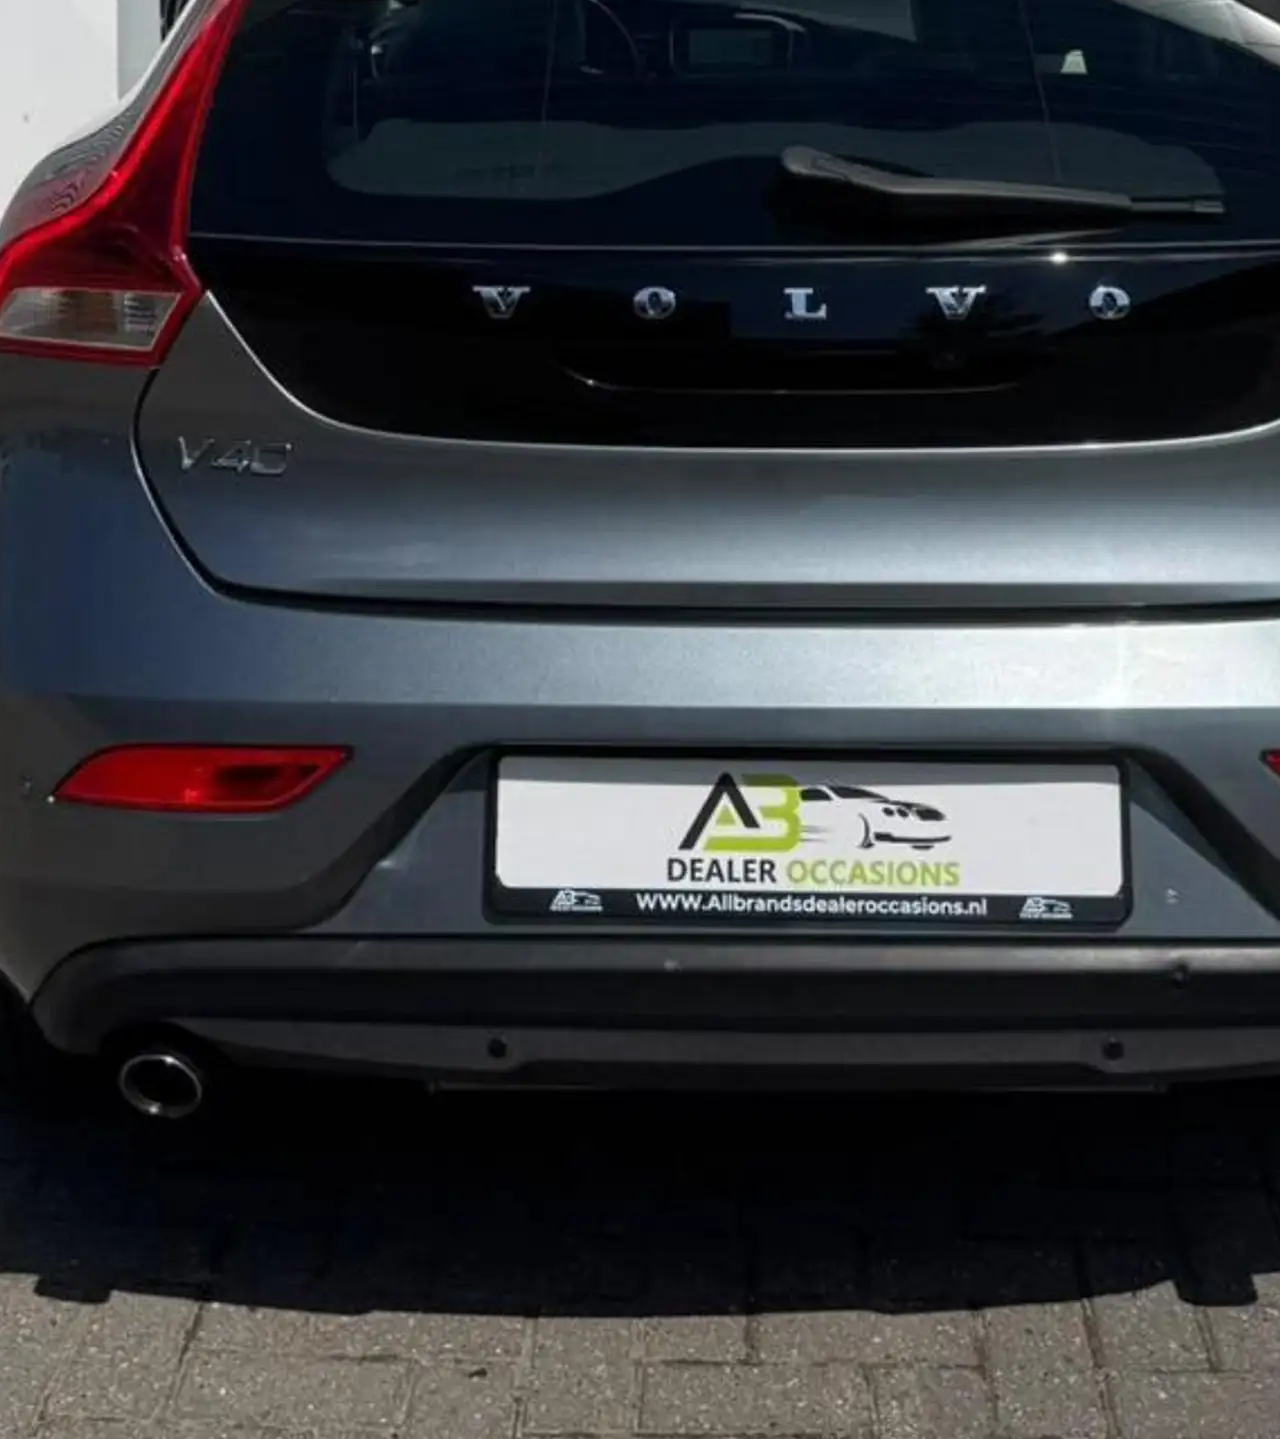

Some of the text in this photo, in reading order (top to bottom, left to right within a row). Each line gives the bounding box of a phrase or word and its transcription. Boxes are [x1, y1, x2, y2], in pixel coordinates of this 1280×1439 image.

[472, 285, 1131, 320] VOLVO
[177, 436, 292, 475] V40
[668, 858, 960, 887] DEALER OCCASIONS
